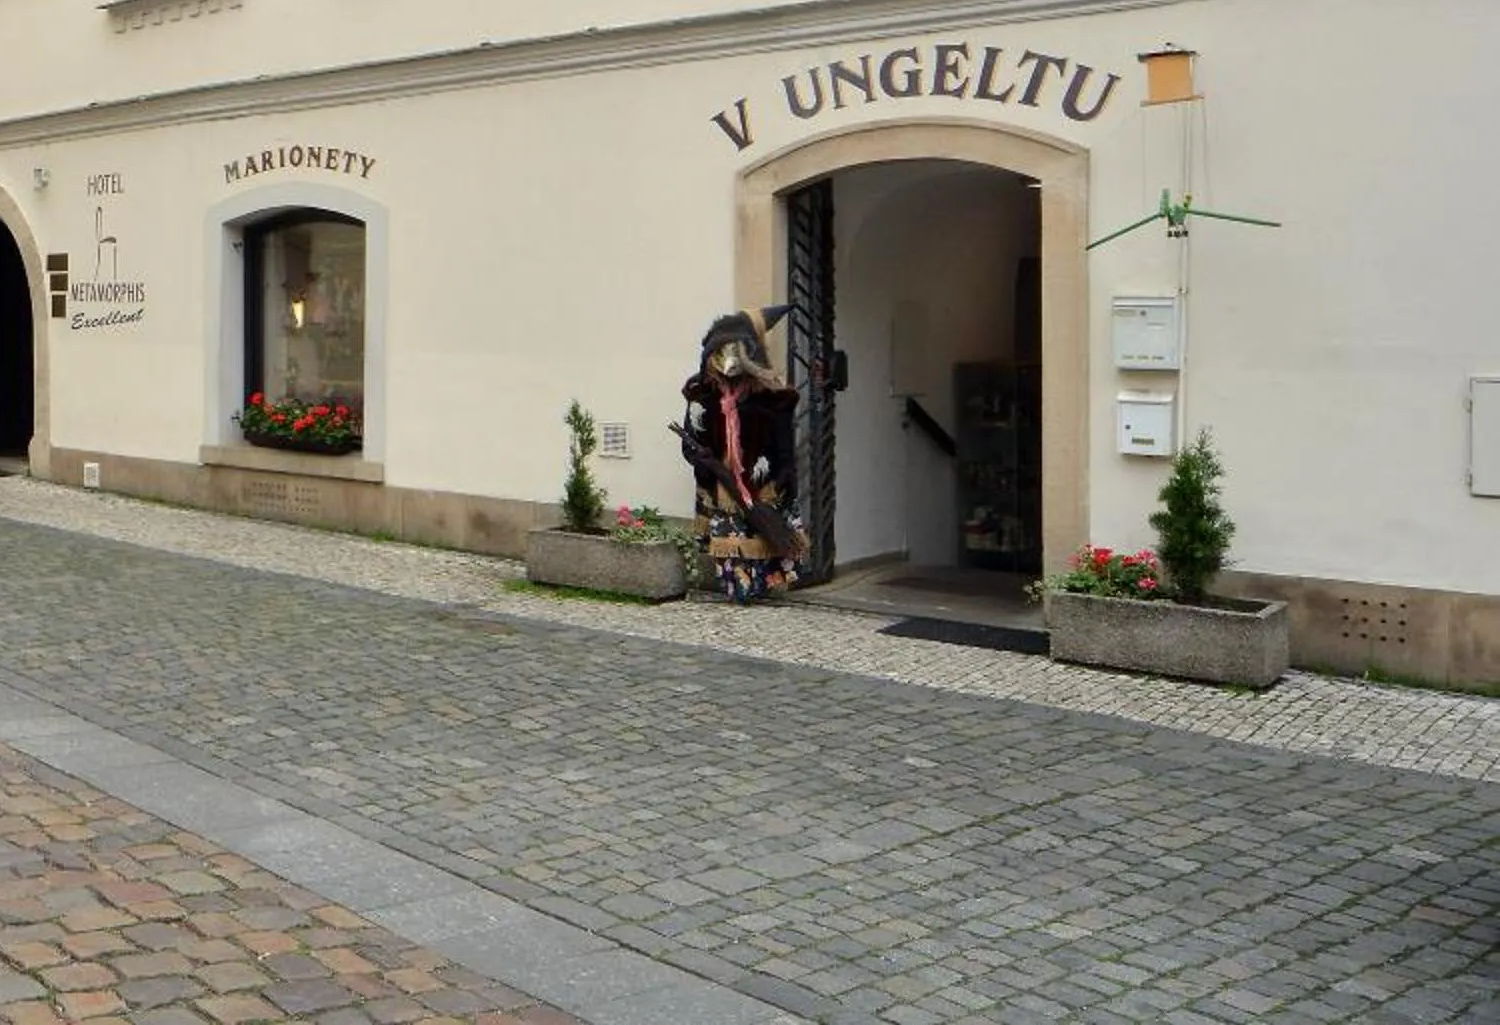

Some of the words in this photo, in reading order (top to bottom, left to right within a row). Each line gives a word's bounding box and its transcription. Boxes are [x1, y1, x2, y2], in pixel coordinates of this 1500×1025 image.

[710, 97, 756, 153] V
[781, 42, 1121, 122] UNGELTU
[223, 144, 377, 184] MARIONETY
[87, 173, 125, 196] HOTEL
[71, 282, 146, 304] METAMORPHIS
[71, 308, 145, 330] Excellent
